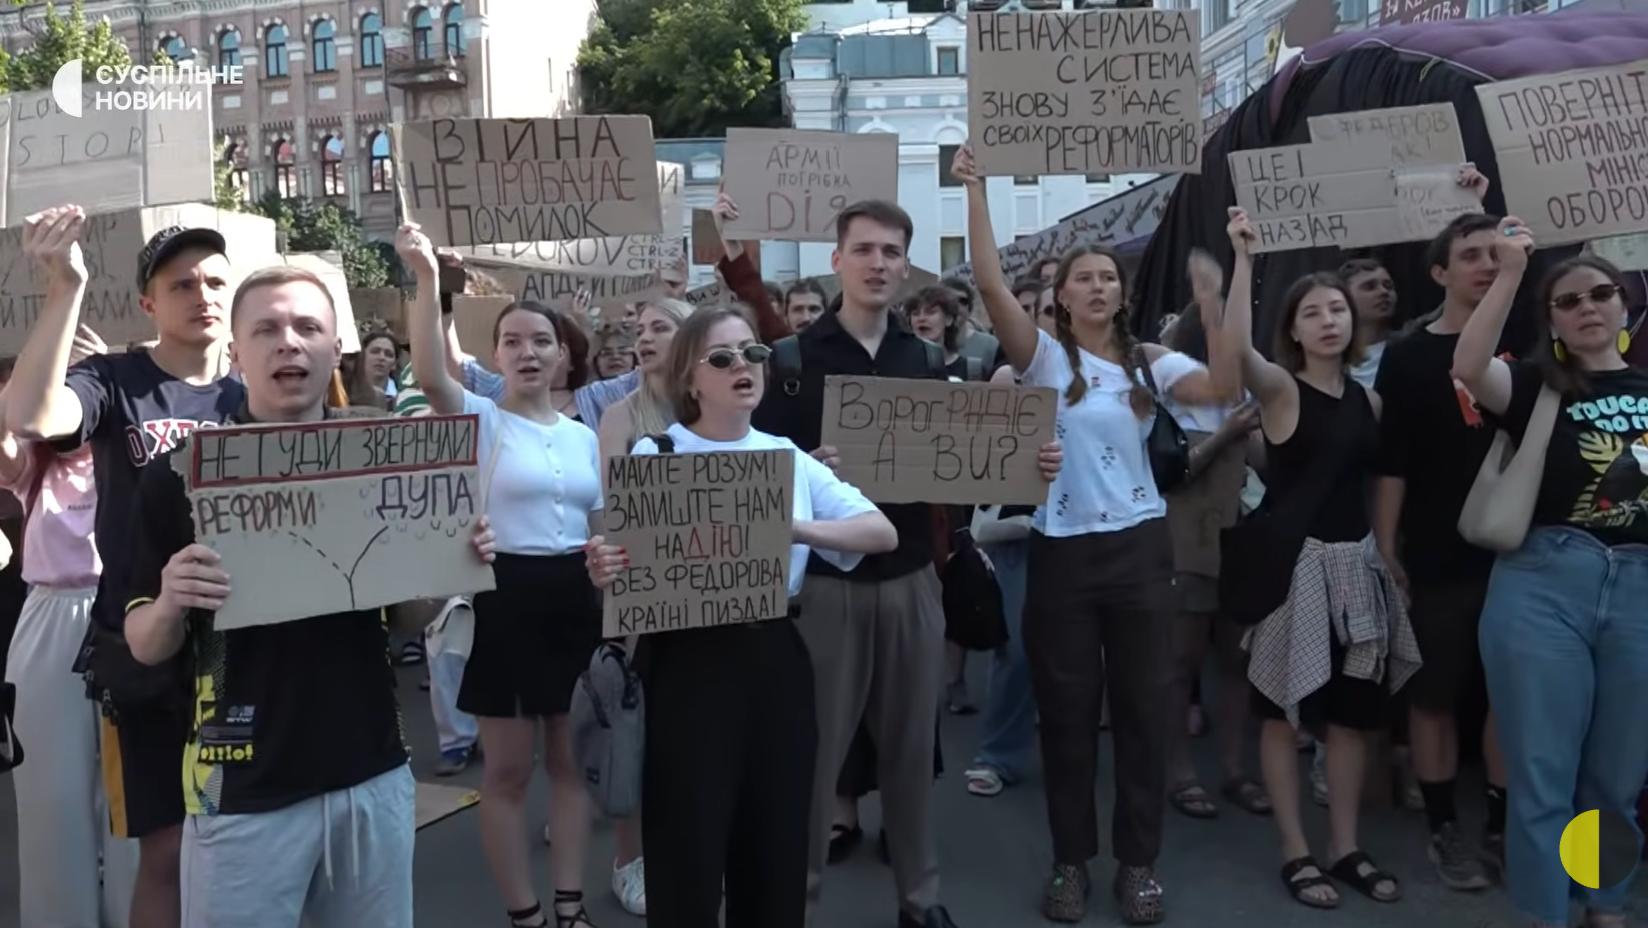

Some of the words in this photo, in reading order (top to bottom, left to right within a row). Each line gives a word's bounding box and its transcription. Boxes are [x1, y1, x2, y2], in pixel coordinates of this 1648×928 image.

[977, 11, 1191, 52] НЕНАЖЕРЛИВА
[1057, 52, 1197, 84] СИСТЕМА
[982, 91, 1069, 119] ЗНОВУ
[432, 117, 621, 164] ВІЙНА
[766, 145, 841, 170] АРМІЇ
[1046, 118, 1198, 173] РЕФОРМАТОРІВ
[410, 161, 466, 208] НЕ
[475, 157, 636, 206] ПРОБАЧАЄ
[1248, 153, 1287, 182] ЦЕ
[1254, 182, 1325, 214] КРОК
[448, 202, 610, 246] ПОМИЛОК
[199, 432, 240, 480] НЕ
[248, 429, 342, 477] ТУДИ
[363, 420, 471, 467] ЗВЕРНУЛИ
[693, 452, 776, 483] РОЗУМ!
[872, 432, 895, 481] А
[199, 490, 317, 535] РЕФОРМИ
[376, 473, 474, 520] ДУПА
[735, 486, 785, 523] НАМ
[664, 557, 784, 596] ФЕДОРОВА
[618, 598, 689, 633] КРАЇНІ
[701, 588, 776, 627] ПИЗДА!
